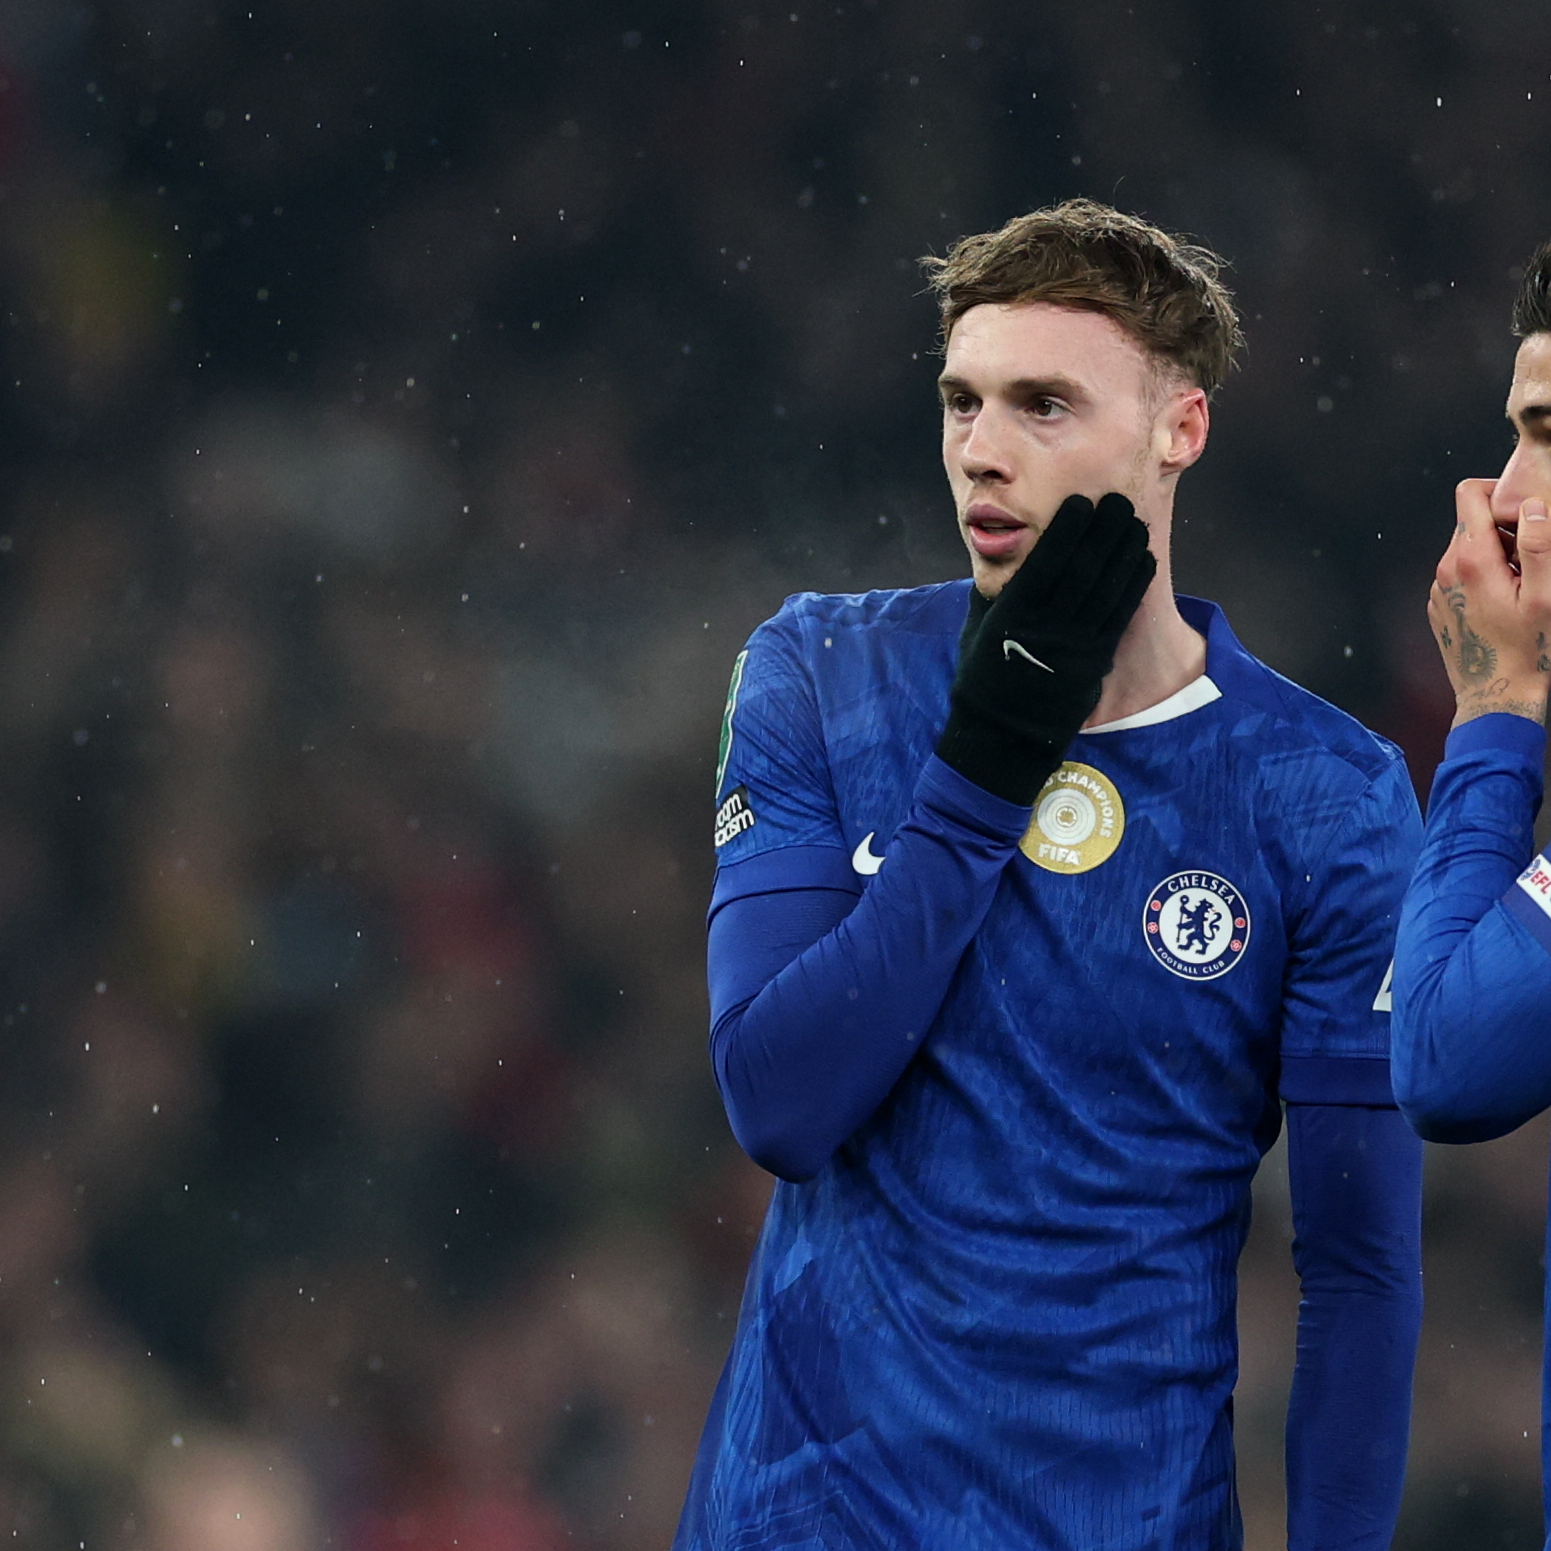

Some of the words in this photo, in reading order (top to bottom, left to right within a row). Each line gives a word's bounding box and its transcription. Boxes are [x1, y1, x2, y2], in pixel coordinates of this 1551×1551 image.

[1056, 771, 1115, 838] CHAMPIONS
[1037, 842, 1081, 866] FIFA
[1167, 874, 1236, 905] CHELSEA
[1156, 946, 1198, 975] FOOTBALL
[1201, 959, 1226, 975] CLUB
